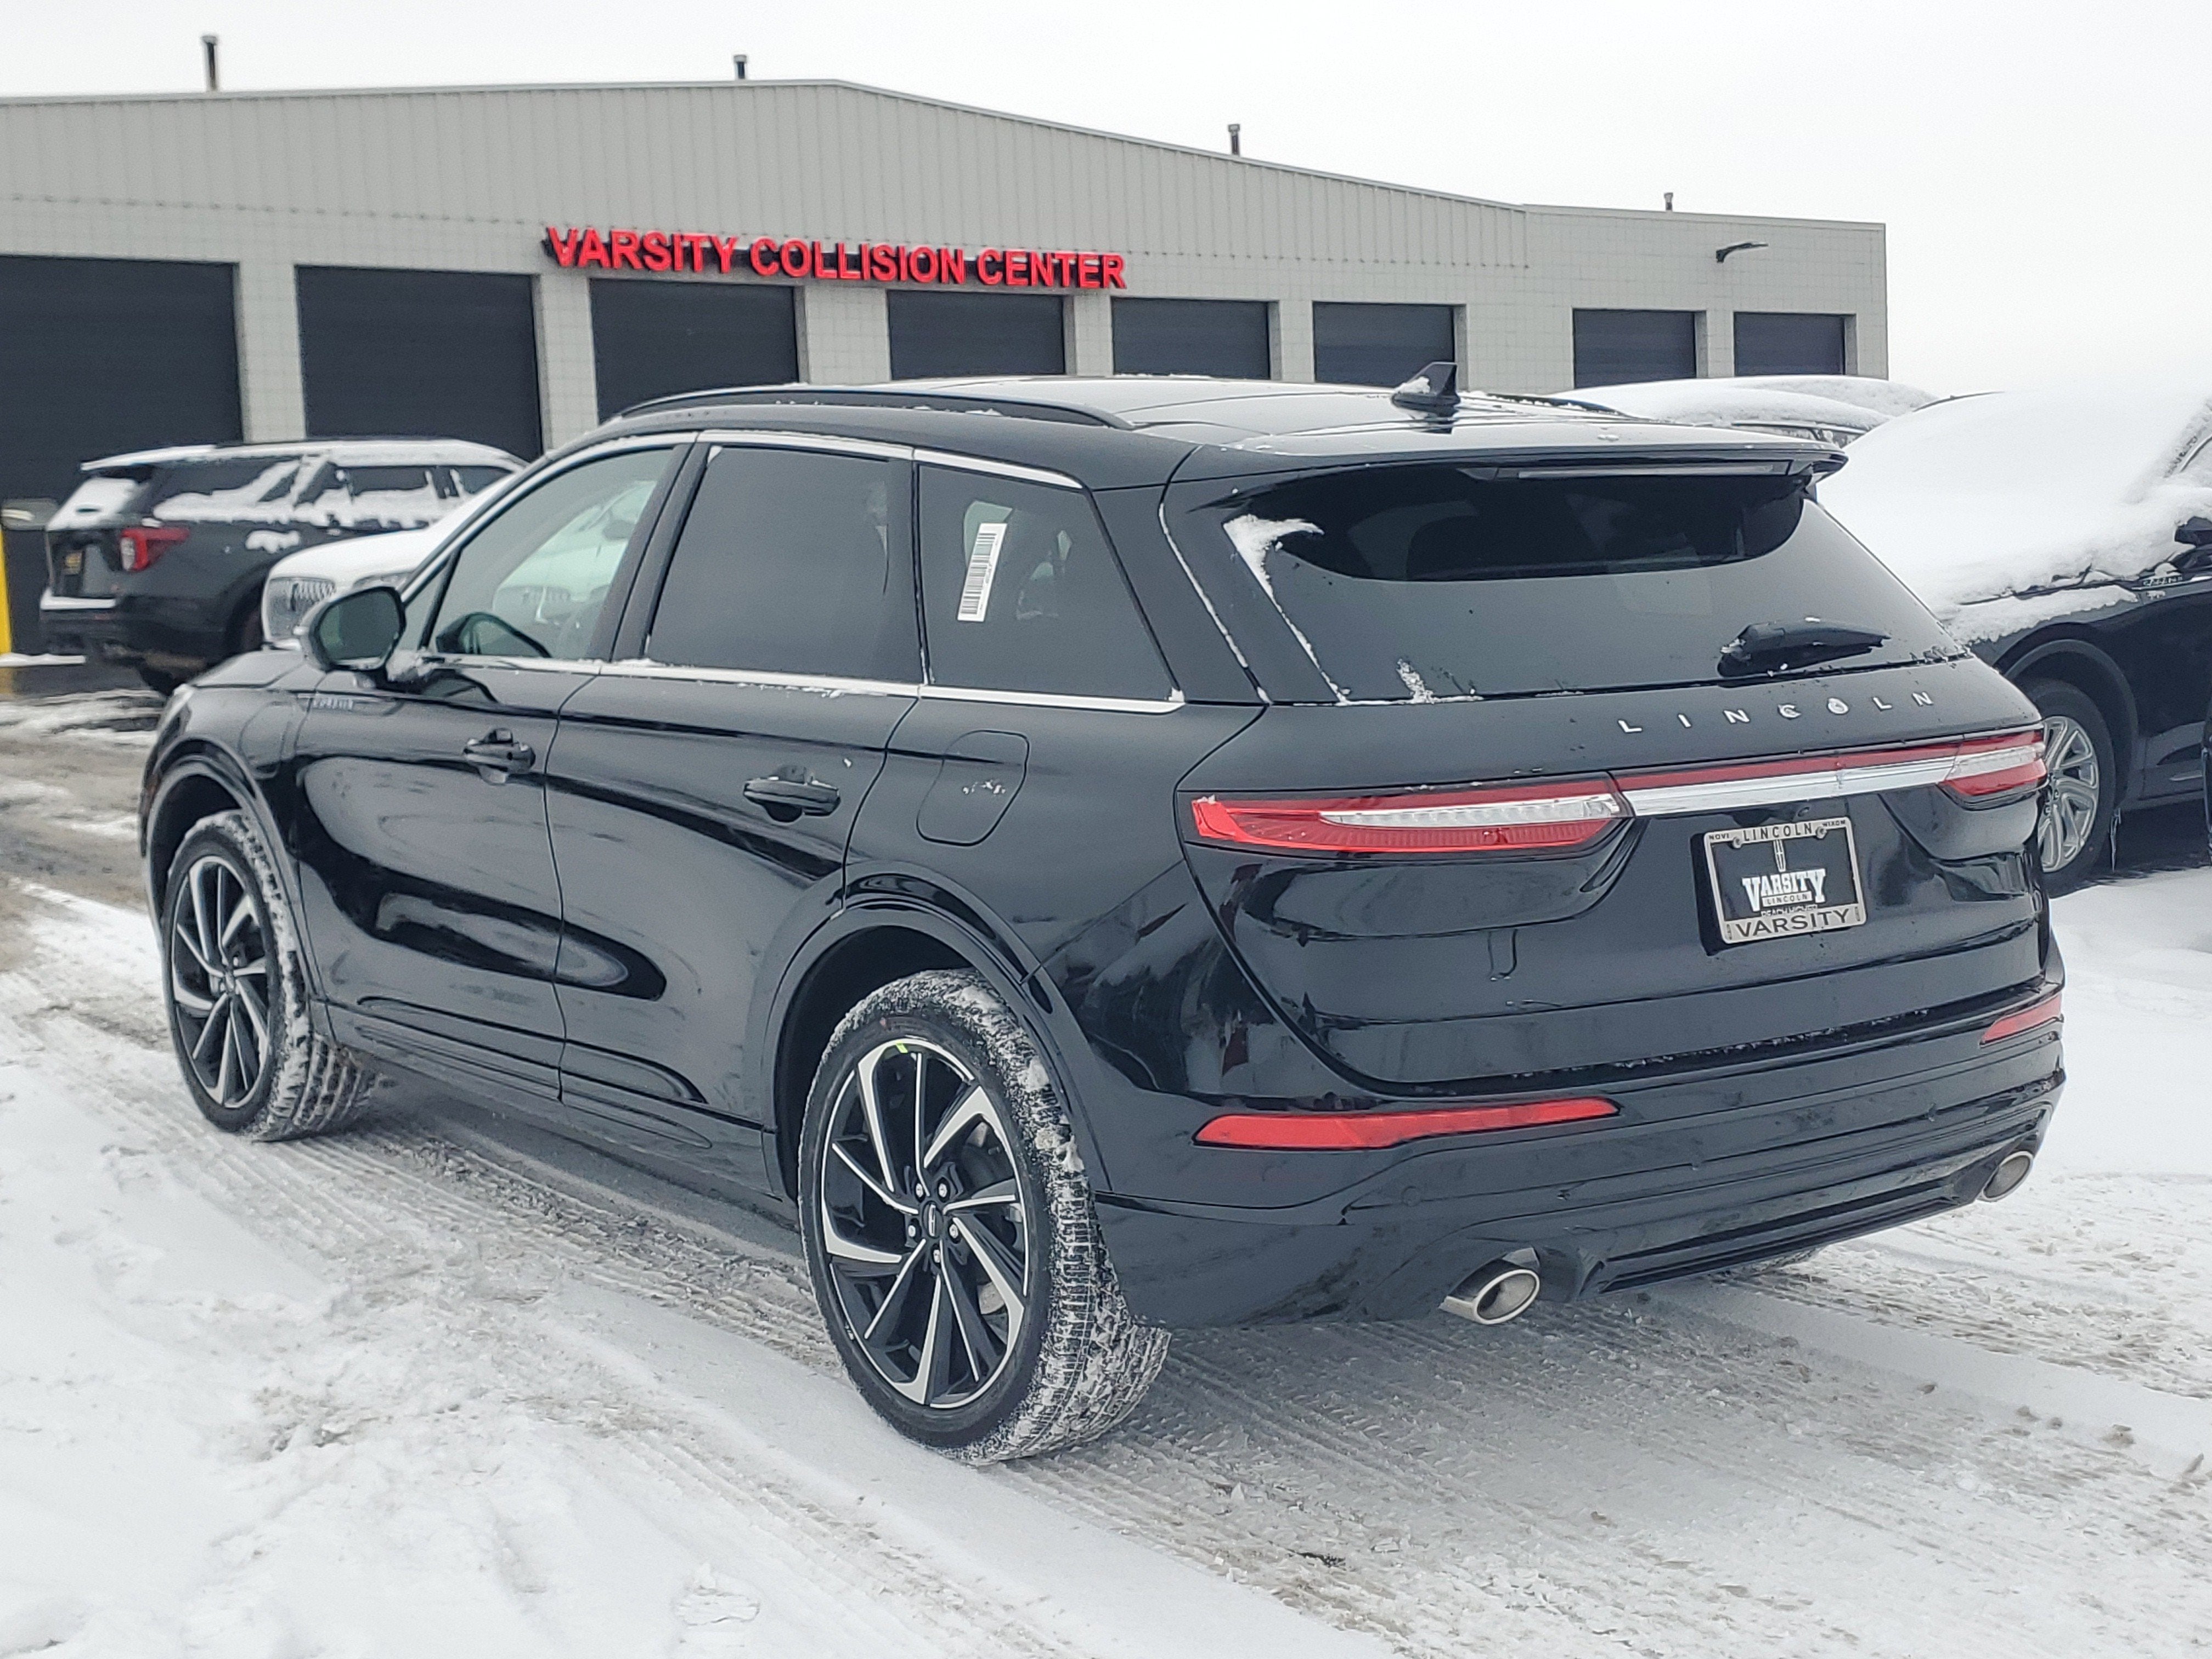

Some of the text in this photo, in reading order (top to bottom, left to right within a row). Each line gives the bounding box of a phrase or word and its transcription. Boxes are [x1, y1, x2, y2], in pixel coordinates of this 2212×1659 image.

[547, 226, 1127, 289] VARSITY COLLISION CENTER
[1618, 691, 1934, 733] LINCOLN
[1743, 822, 1813, 842] LINCOLN
[1741, 868, 1826, 912] VARSITY
[1767, 894, 1808, 905] LINCOLN
[1735, 908, 1850, 938] VARSITY
